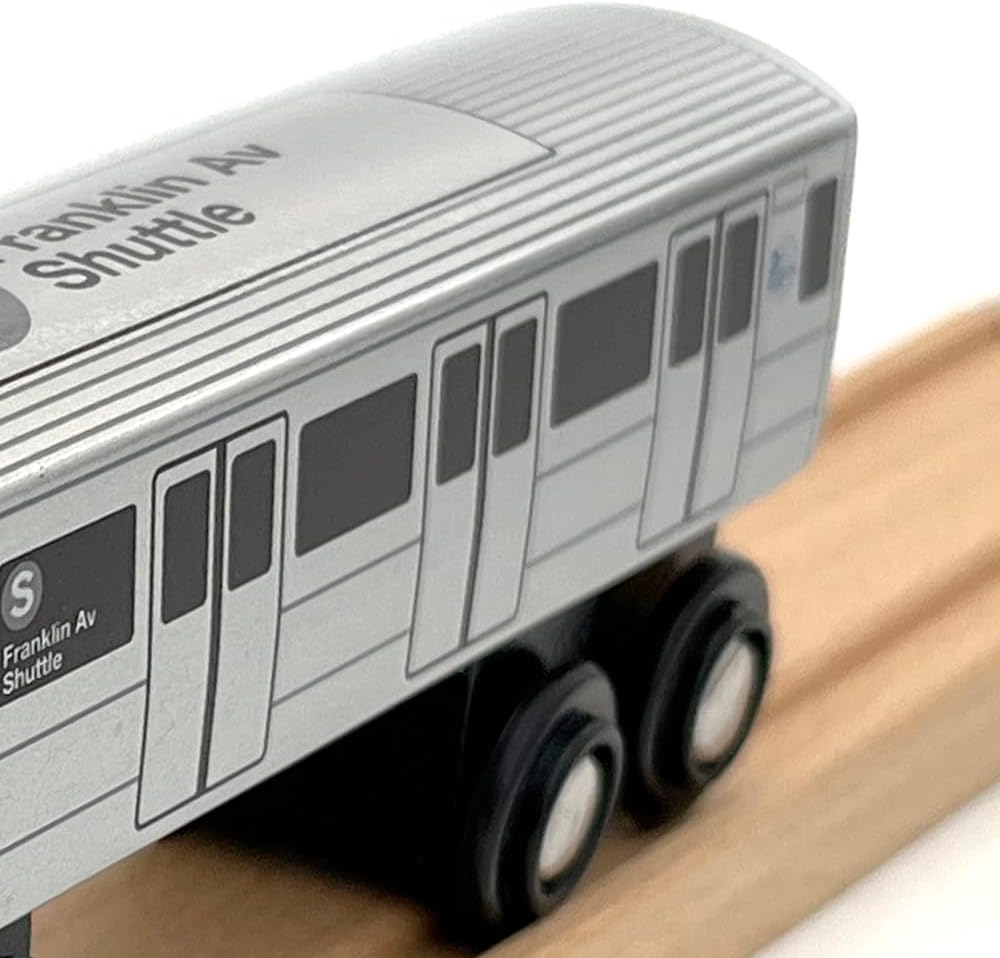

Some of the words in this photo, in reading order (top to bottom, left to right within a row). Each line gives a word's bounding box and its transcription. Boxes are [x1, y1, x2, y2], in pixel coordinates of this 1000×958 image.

[188, 143, 281, 177] Av
[22, 203, 256, 290] Shuttle
[10, 570, 34, 618] S
[3, 621, 71, 669] Franklin
[75, 609, 97, 634] Av
[2, 651, 63, 695] Shuttle
